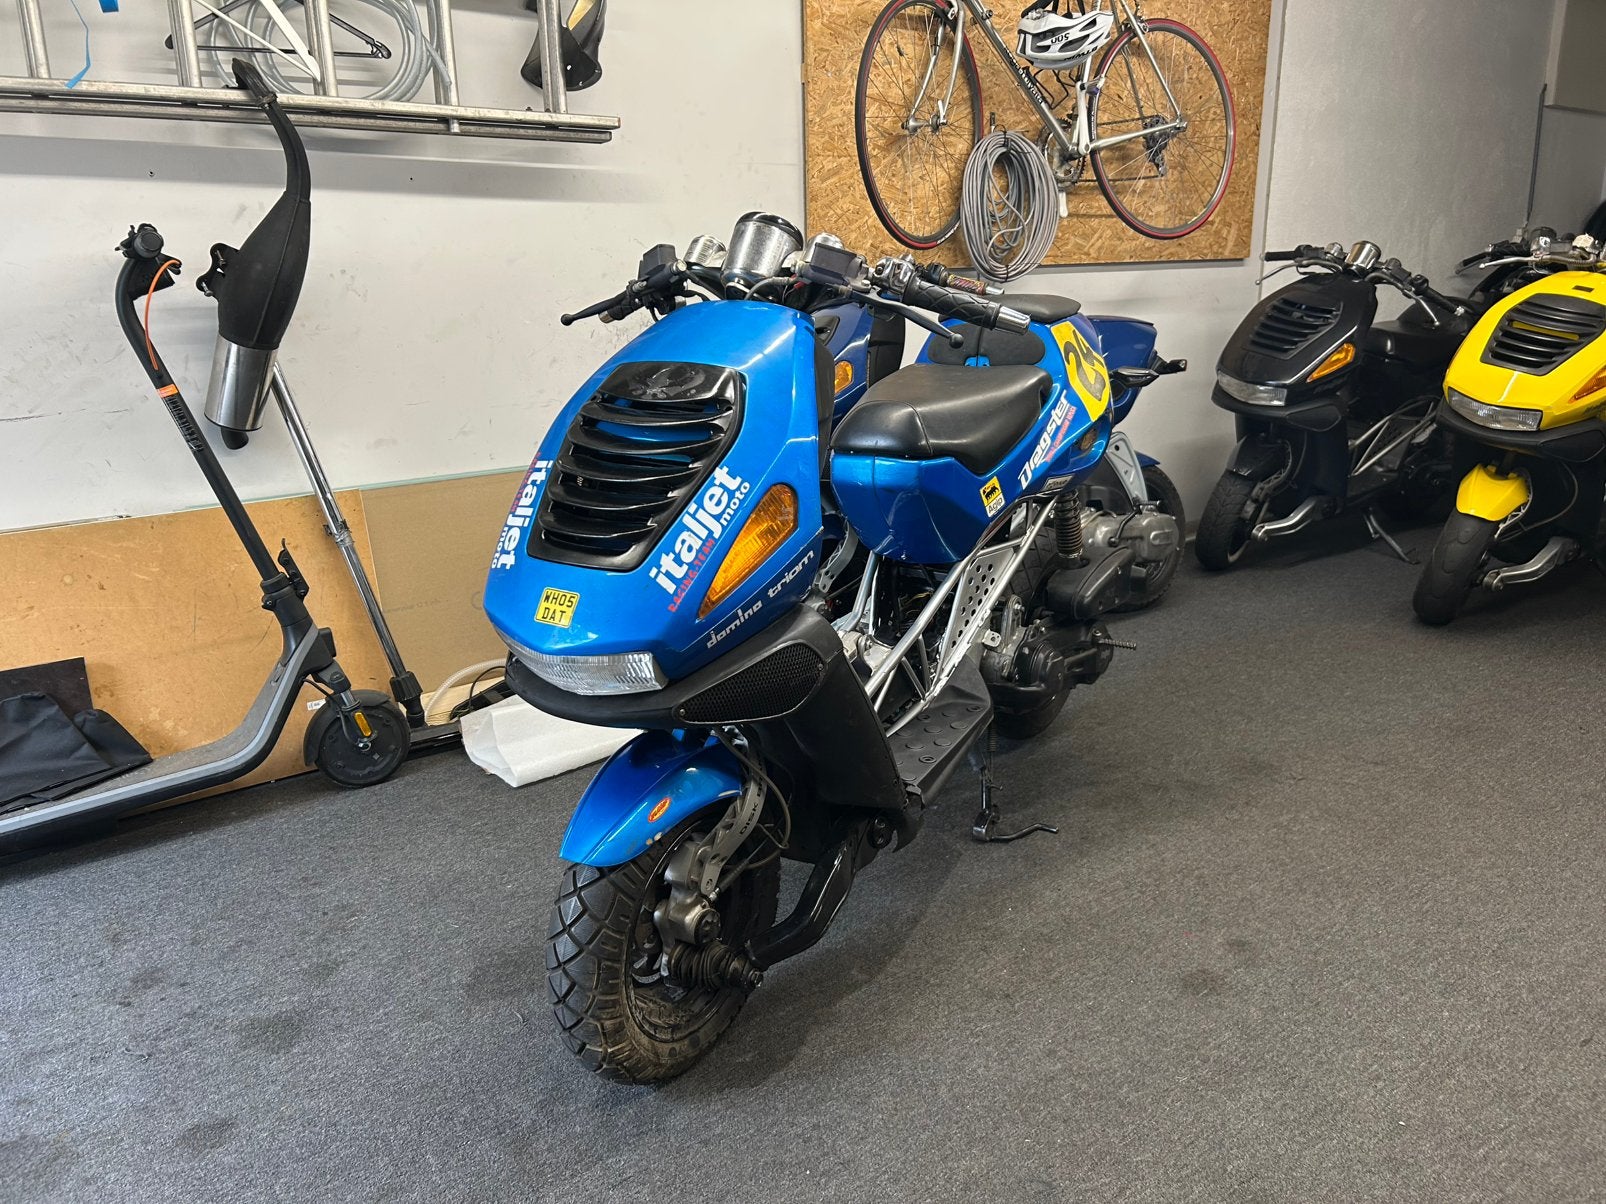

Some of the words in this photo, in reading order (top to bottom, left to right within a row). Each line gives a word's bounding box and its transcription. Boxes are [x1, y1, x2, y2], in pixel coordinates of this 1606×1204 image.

[1051, 32, 1071, 44] 500
[1063, 329, 1105, 402] 24
[497, 460, 554, 570] italjet
[720, 481, 751, 527] moto
[988, 497, 1004, 515] Agip
[491, 526, 508, 569] moto
[648, 465, 743, 595] italjet
[541, 606, 567, 623] DAT
[706, 600, 763, 649] domino
[740, 802, 759, 835] DISK
